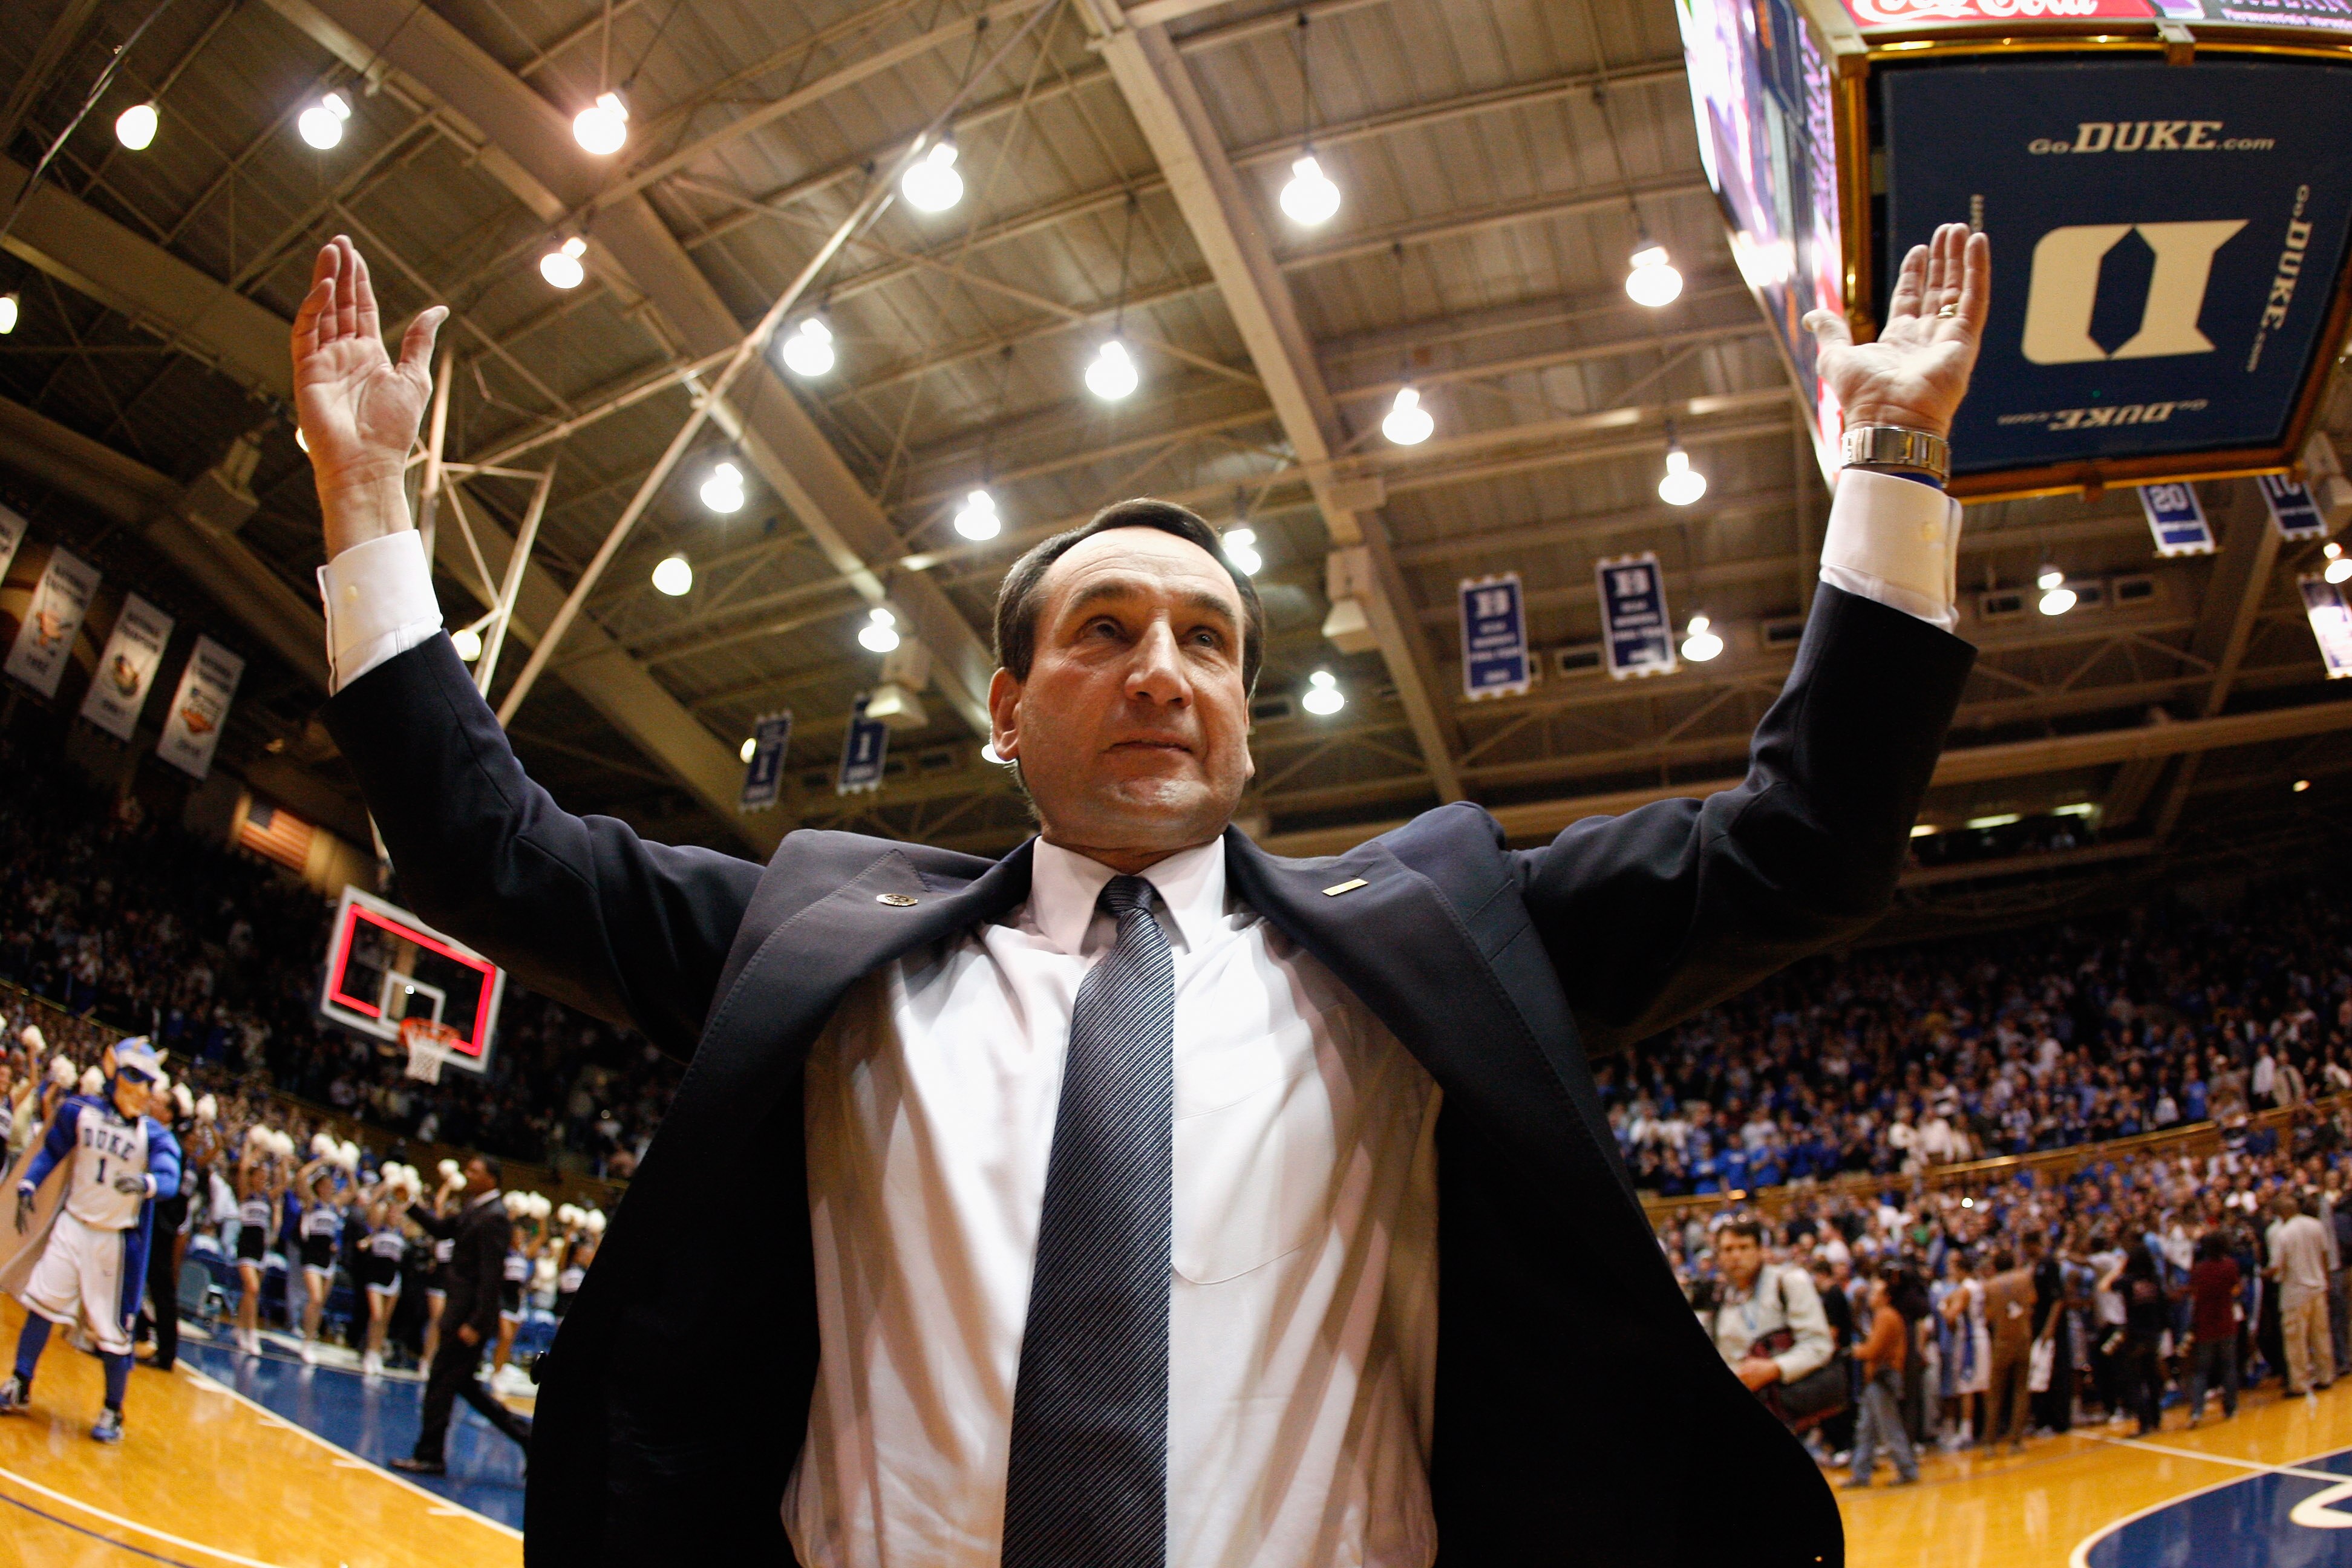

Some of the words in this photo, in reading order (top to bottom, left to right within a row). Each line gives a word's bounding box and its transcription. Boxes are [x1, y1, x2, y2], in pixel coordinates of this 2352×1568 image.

[2028, 120, 2276, 155] GoDUKE.com
[83, 1127, 135, 1161] DUKE
[95, 1157, 107, 1184] 1
